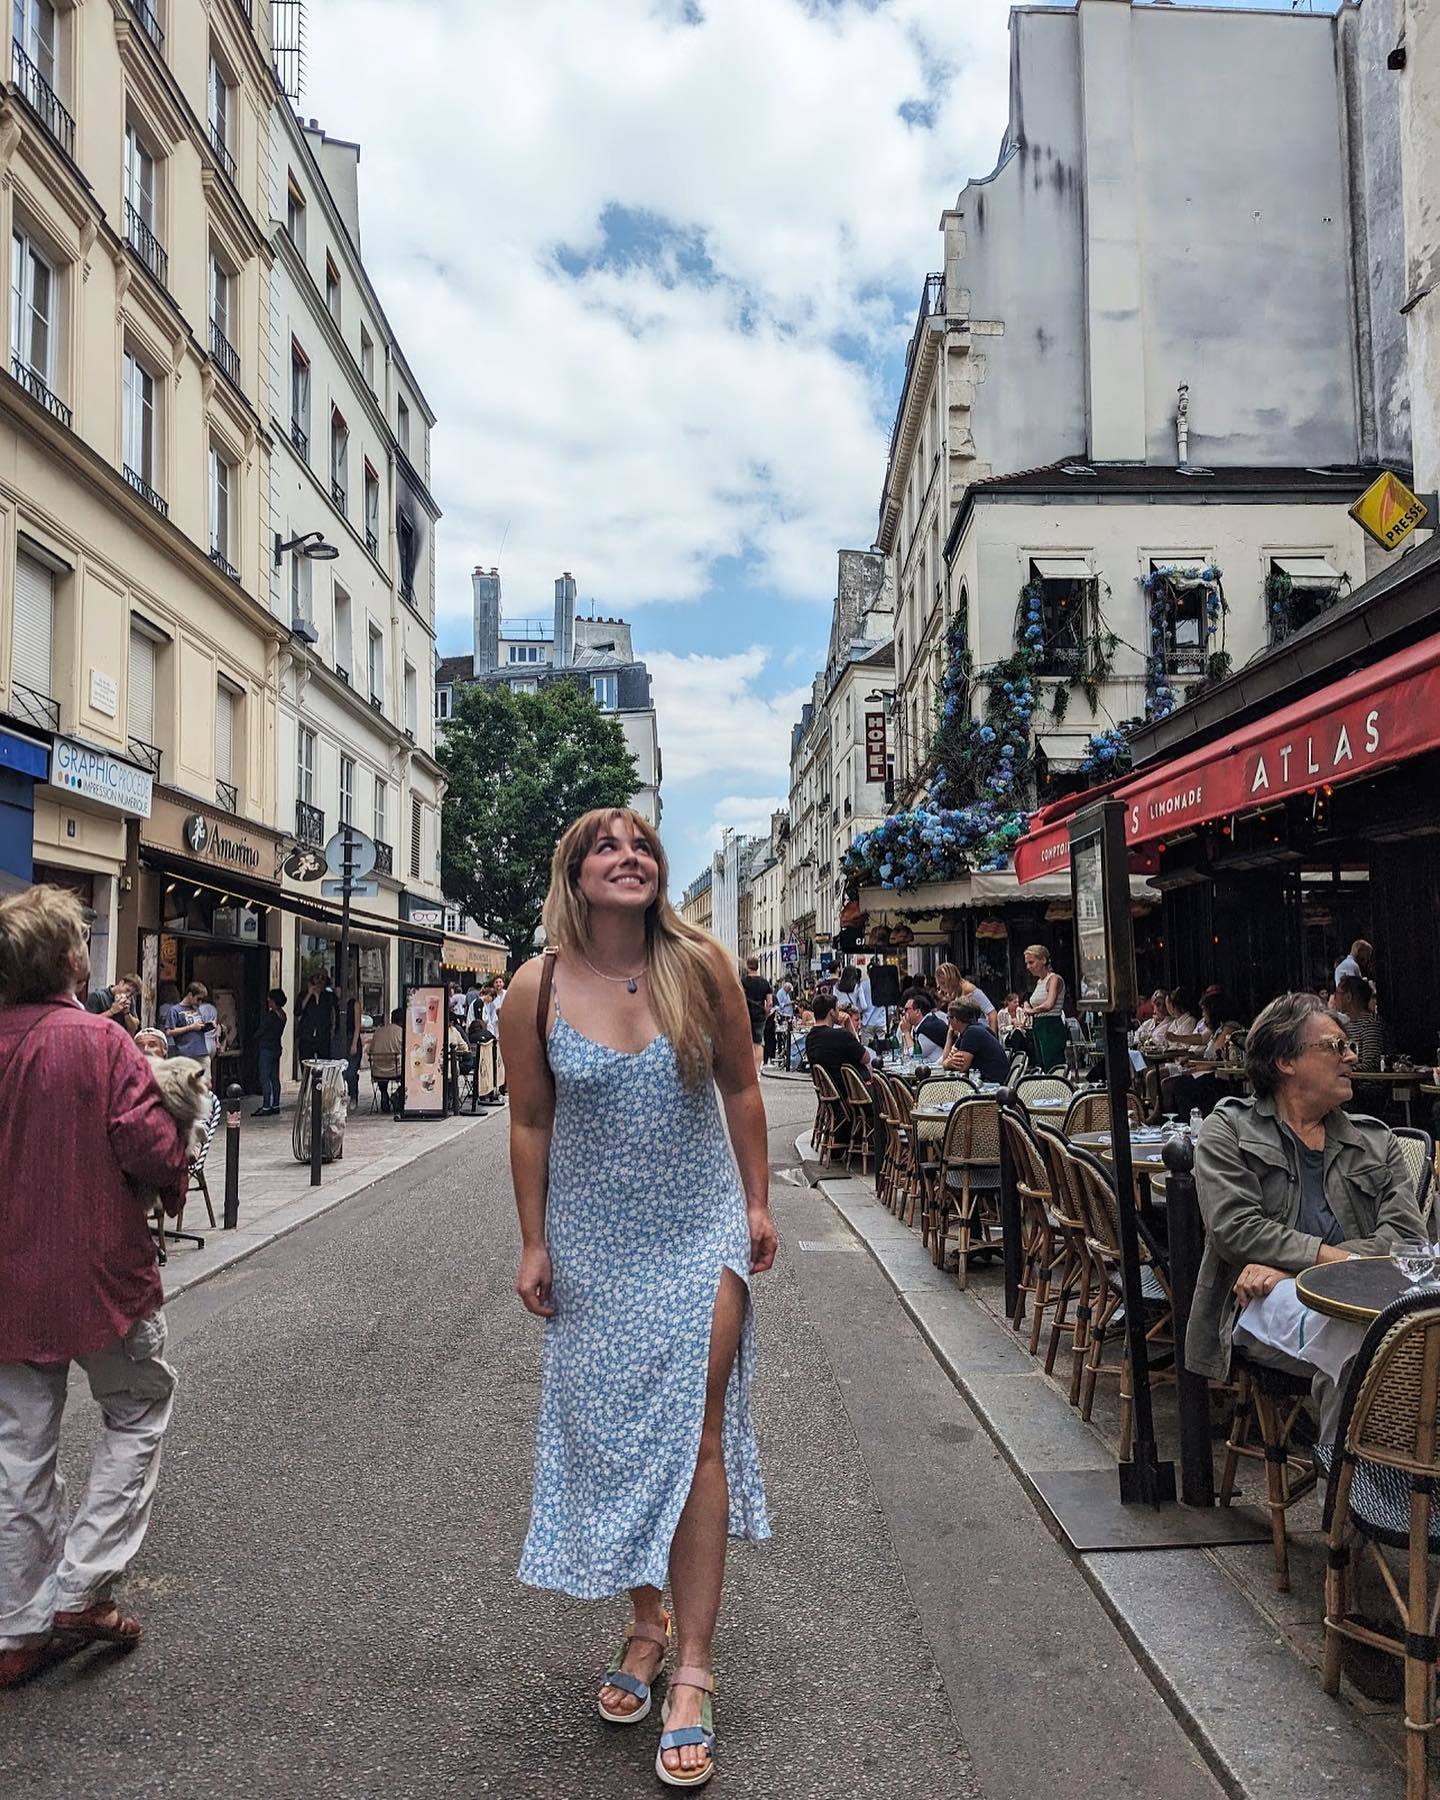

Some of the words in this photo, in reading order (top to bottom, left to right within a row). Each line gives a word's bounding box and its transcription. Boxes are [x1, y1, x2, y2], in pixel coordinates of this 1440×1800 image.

[1385, 503, 1423, 542] PRESSE
[57, 743, 119, 788] GRAPHIC
[867, 717, 885, 778] HOTEL
[1150, 786, 1202, 820] LIMONADE
[1252, 710, 1380, 793] ATLAS
[83, 780, 117, 802] IMPRESSION
[205, 823, 260, 869] Amorino
